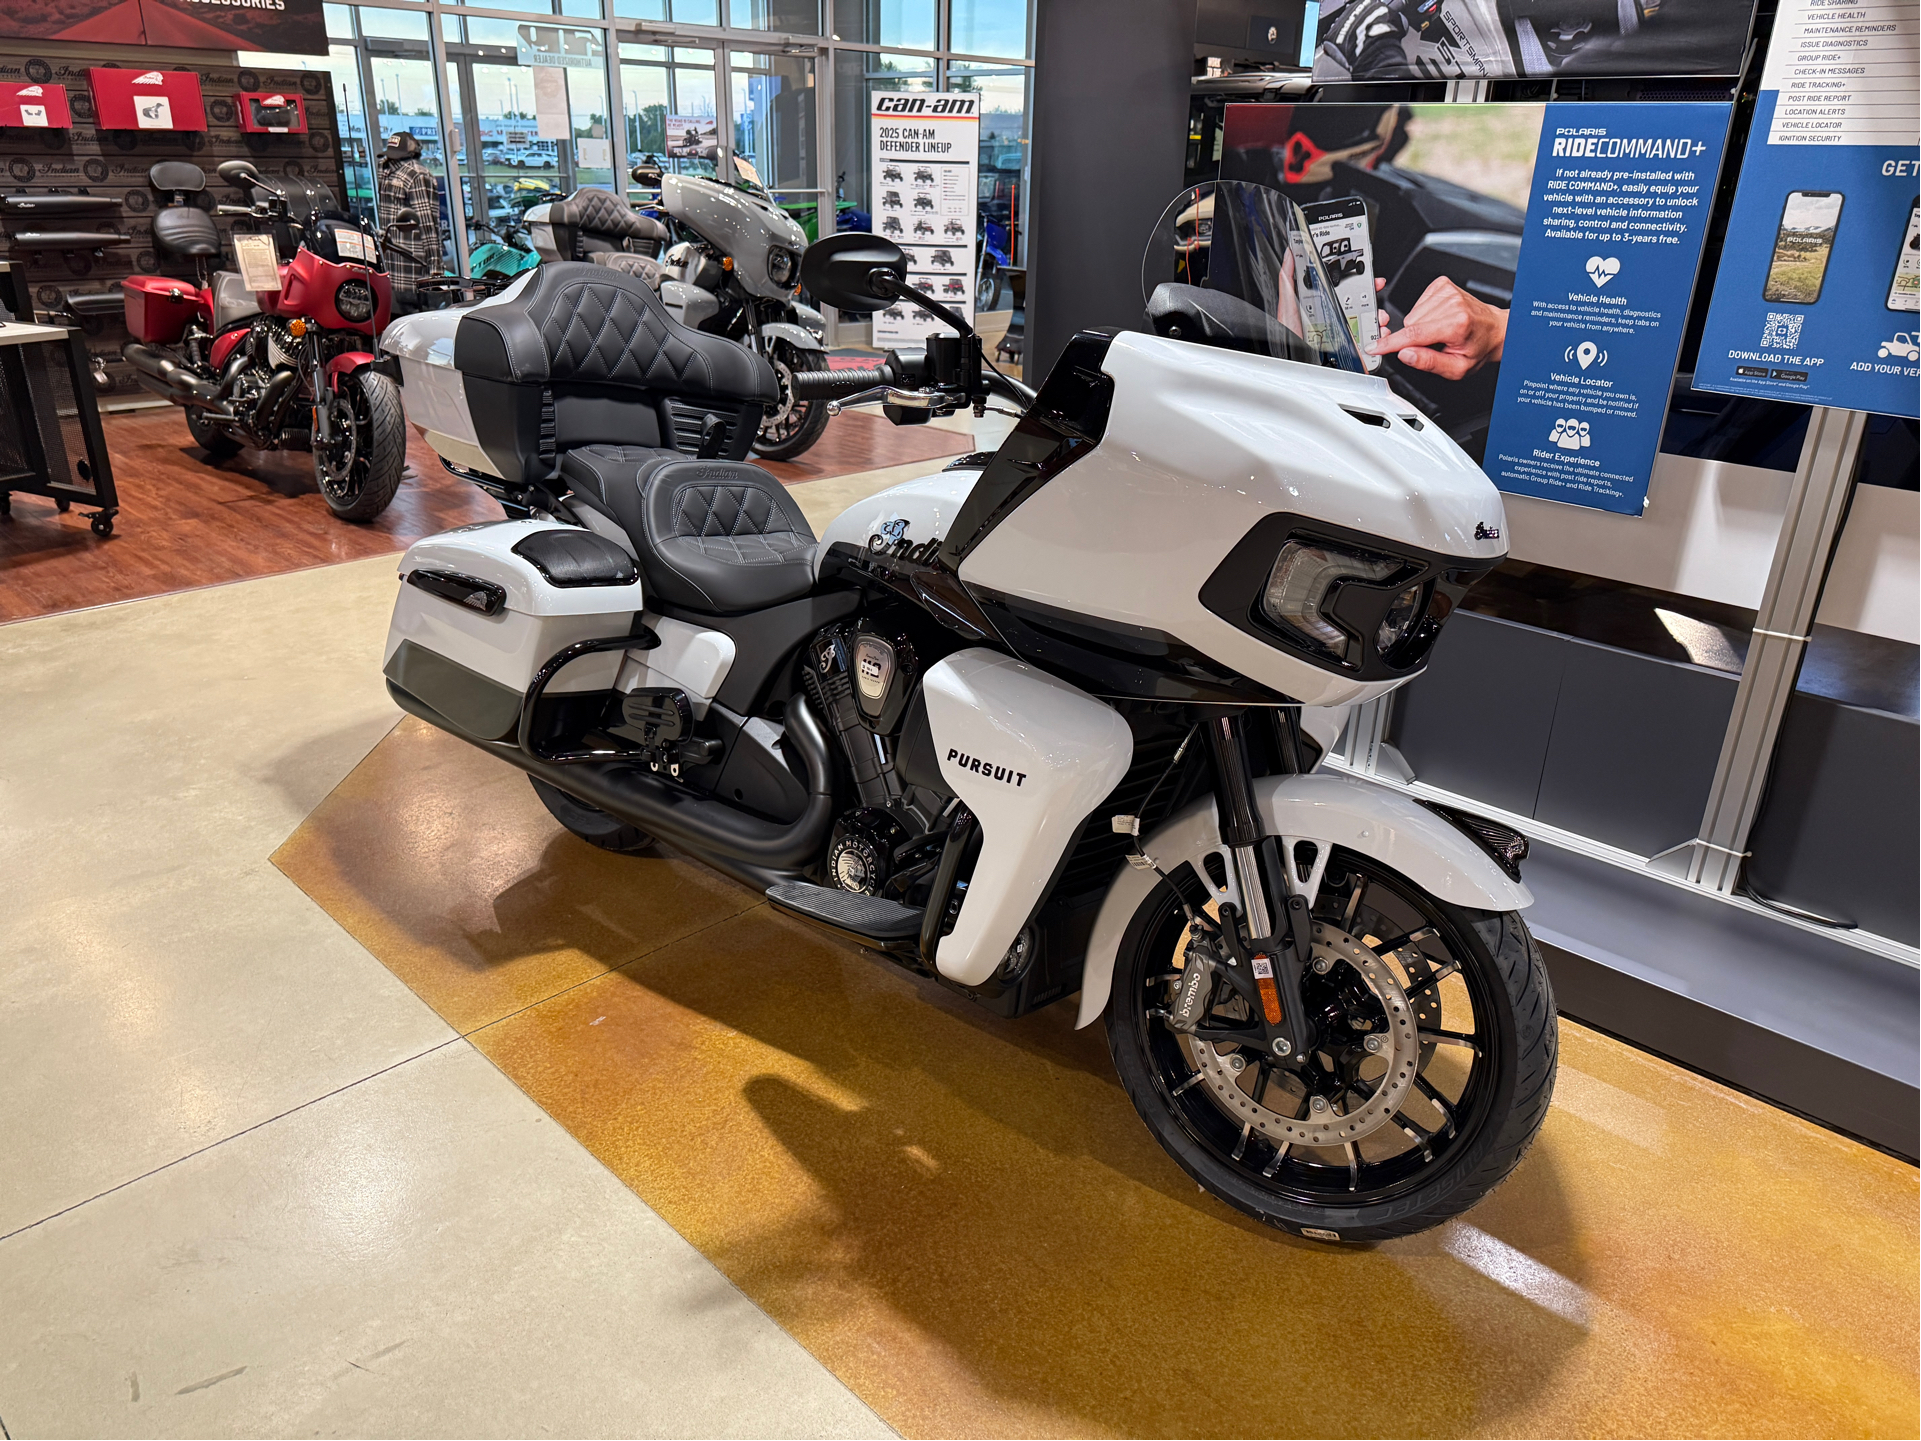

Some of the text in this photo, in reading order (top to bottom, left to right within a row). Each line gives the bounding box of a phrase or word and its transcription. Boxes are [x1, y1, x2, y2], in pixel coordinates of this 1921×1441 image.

[1804, 24, 1897, 34] MAINTENANCE REMINDERS
[1443, 10, 1489, 78] SPORTSMAN
[1822, 39, 1869, 47] DIAGNOSTICS
[876, 97, 975, 114] can-am
[880, 127, 935, 139] 2025 CAN-AM
[880, 140, 951, 153] DEFENDER LINEUP
[1552, 138, 1706, 158] RIDECOMMAND+
[1556, 169, 1563, 177] If
[1579, 169, 1612, 180] already
[1613, 170, 1673, 180] pre-installed
[1674, 171, 1695, 180] with
[1882, 159, 1920, 176] GET
[1548, 180, 1699, 195] RIDE COMMAND+, easily equip your
[1544, 193, 1573, 202] vehicle
[1575, 194, 1594, 202] with
[1607, 197, 1654, 207] accessory
[1656, 197, 1665, 205] to
[1667, 197, 1698, 206] unlock
[1318, 212, 1343, 221] POLARIS
[1552, 206, 1683, 218] next-level vehicle information
[1543, 217, 1687, 233] sharing, control and connectivity.
[1545, 229, 1680, 244] Available for up to 3-years free.
[1787, 237, 1822, 245] POLARIS
[1568, 293, 1627, 305] Vehicle Health
[1543, 312, 1583, 320] maintenance
[1618, 317, 1634, 326] keep
[1600, 307, 1622, 315] health,
[1623, 309, 1661, 318] diagnostics
[1602, 326, 1635, 334] anywhere.
[1728, 350, 1824, 366] DOWNLOAD THE APP
[1850, 362, 1872, 371] ADD
[1874, 364, 1901, 375] YOUR
[1524, 380, 1548, 389] Pinpoint
[1551, 373, 1613, 387] Vehicle Locator
[1532, 398, 1552, 406] vehicle
[1564, 402, 1580, 410] been
[1580, 405, 1606, 413] bumped
[1559, 394, 1586, 403] property
[1533, 449, 1600, 467] Rider Experience
[1499, 454, 1518, 462] Polaris
[1519, 458, 1540, 466] owners
[1541, 462, 1563, 470] receive
[1574, 467, 1599, 476] ultimate
[1600, 472, 1634, 482] connected
[1514, 466, 1546, 475] experience
[1588, 478, 1612, 487] reports,
[1501, 471, 1530, 480] automatic
[1530, 475, 1548, 484] Group
[1549, 478, 1565, 486] Ride+
[1594, 486, 1624, 497] Tracking+.
[947, 748, 1026, 787] PURSUIT
[1179, 972, 1201, 1017] brembo
